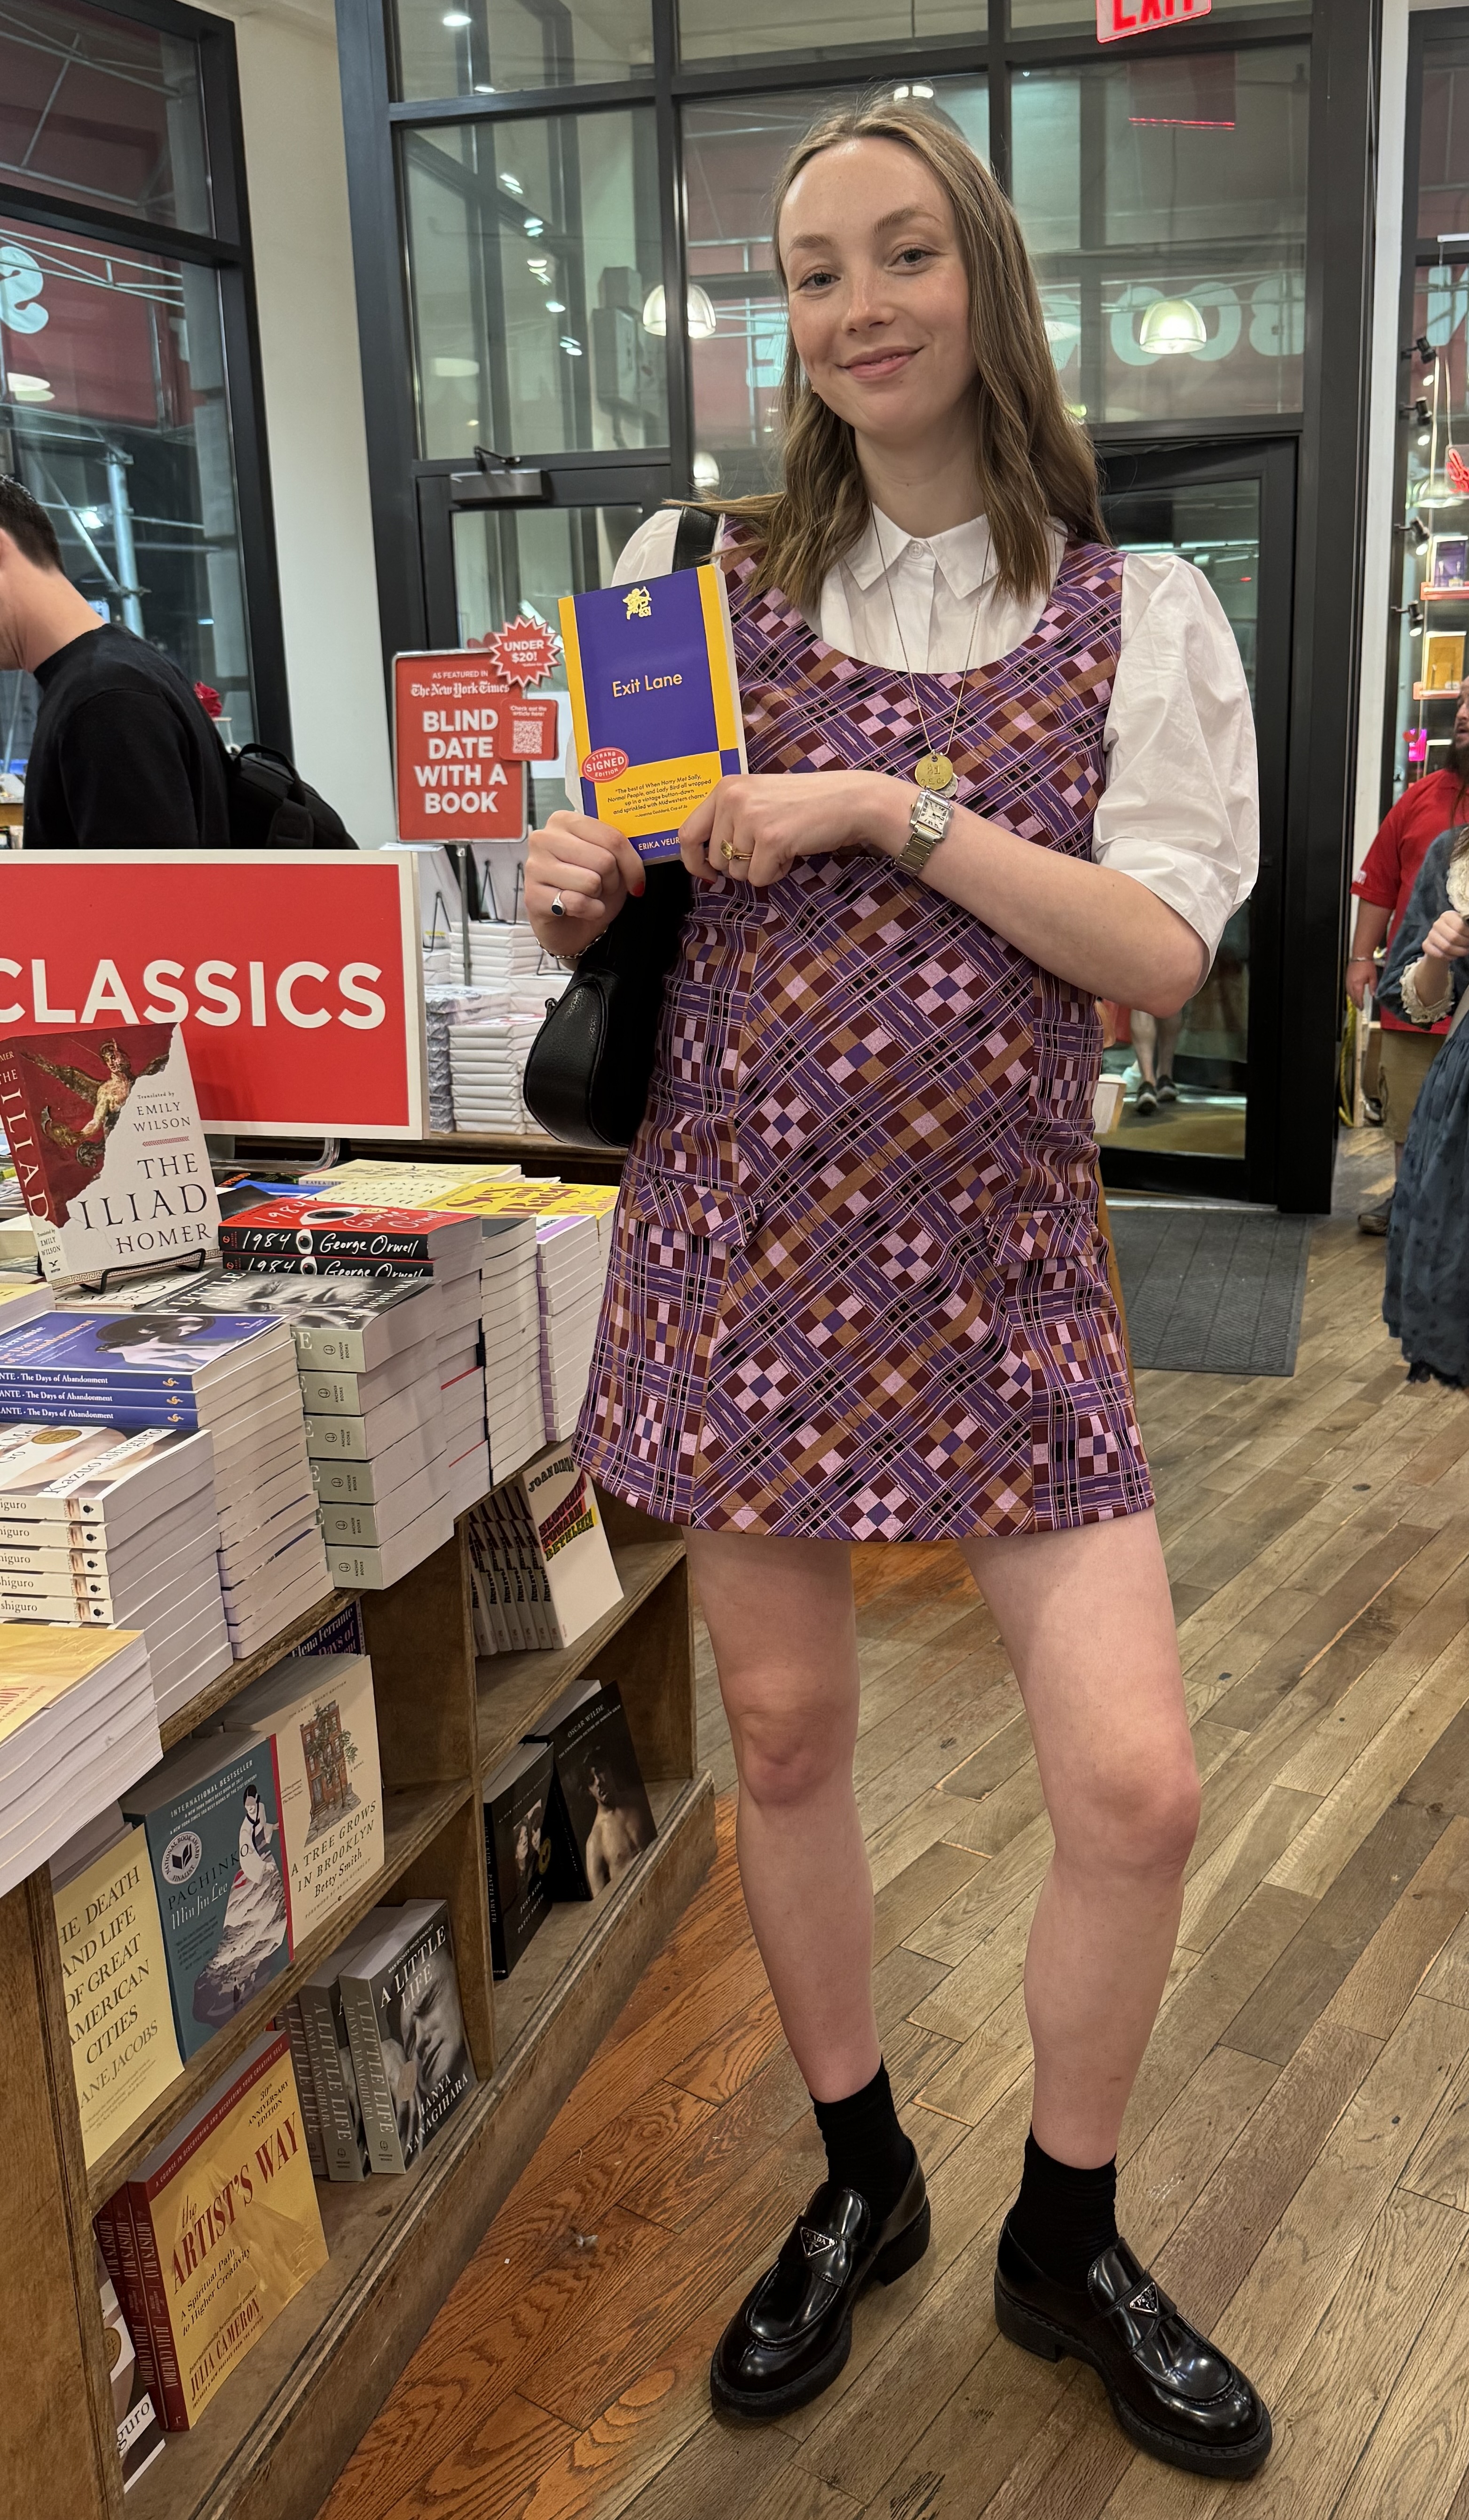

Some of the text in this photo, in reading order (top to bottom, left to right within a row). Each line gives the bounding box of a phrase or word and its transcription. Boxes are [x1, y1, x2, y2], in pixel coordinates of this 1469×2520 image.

[504, 640, 544, 651] UNDER
[512, 652, 537, 663] $20!
[411, 680, 509, 698] The New York Times
[613, 674, 682, 697] Exit Lane
[423, 709, 498, 732] BLIND
[428, 737, 494, 759] DATE
[592, 751, 616, 761] STRAND
[414, 764, 507, 786] WITH A
[586, 757, 624, 772] SIGNED
[595, 768, 618, 777] EDITION
[642, 794, 661, 803] vintage
[688, 779, 711, 787] wrapped
[425, 792, 498, 814] BOOK
[624, 804, 646, 813] sprinkled
[658, 796, 688, 806] Midwestern
[638, 840, 660, 850] ERIKA
[133, 1117, 191, 1131] WILSON
[137, 1102, 181, 1116] EMILY
[1, 1088, 49, 1220] ILIAD
[137, 1153, 198, 1179] THE
[78, 1184, 207, 1230] ILIAD
[254, 1201, 318, 1223] 1984
[446, 1187, 517, 1208] Sex
[343, 1210, 407, 1228] George
[388, 1211, 450, 1229] Orwell
[40, 1237, 56, 1247] EMILY
[41, 1245, 61, 1256] WILSON
[116, 1223, 212, 1254] HOMER
[243, 1231, 291, 1250] 1984
[320, 1232, 367, 1255] George
[370, 1234, 419, 1257] Orwell
[169, 1272, 247, 1306] LITTLE
[197, 1284, 253, 1307] LIFE
[35, 1374, 52, 1383] Days
[62, 1374, 108, 1384] Abandonment
[42, 1461, 102, 1494] Kazuo
[99, 1428, 163, 1464] Ishiguro
[529, 1466, 554, 1493] JOAN
[1, 1600, 37, 1613] shiguro
[318, 1607, 353, 1642] Ferrante
[344, 1620, 354, 1641] of
[568, 1704, 605, 1738] OSCAR WILDE
[171, 1760, 253, 1817] INTERNATIONAL BESTSELLER
[291, 1801, 376, 1877] A TREE GROWS
[165, 1841, 178, 1875] NATIONAL
[191, 1837, 200, 1859] AWARD
[298, 1819, 374, 1892] IN BROOKLYN
[168, 1844, 249, 1910] PACHINKO
[173, 1865, 195, 1881] FINALIST
[315, 1848, 362, 1898] Betty Smith
[85, 1866, 141, 1925] DEATH
[172, 1883, 228, 1930] Min Jin Lee
[100, 1905, 136, 1946] LIFE
[396, 1951, 411, 1966] BOOKER
[410, 1940, 419, 1953] PRIZE
[419, 1924, 434, 1942] FINALIST
[88, 1933, 141, 1992] GREAT
[380, 1925, 446, 2009] A LITTLE
[401, 1963, 433, 2010] LIFE
[87, 2004, 138, 2064] CITIES
[112, 2020, 158, 2080] JACOBS
[347, 2007, 372, 2120] HANYA YANAGIHARA
[356, 1996, 394, 2133] A LITTLE LIFE
[248, 2080, 288, 2126] ANNIVERSARY
[418, 2073, 452, 2120] HANYA
[258, 2099, 283, 2127] EDITION
[406, 2073, 468, 2155] YANAGIHARA
[160, 2163, 176, 2182] COURSE
[183, 2124, 209, 2157] DISCOVERING
[254, 2111, 299, 2184] WAY
[182, 2195, 197, 2228] the
[181, 2249, 235, 2322] A Spiritual Path
[183, 2247, 251, 2337] to Higher Creativity
[190, 2353, 215, 2402] JULIA
[216, 2295, 260, 2361] CAMERON
